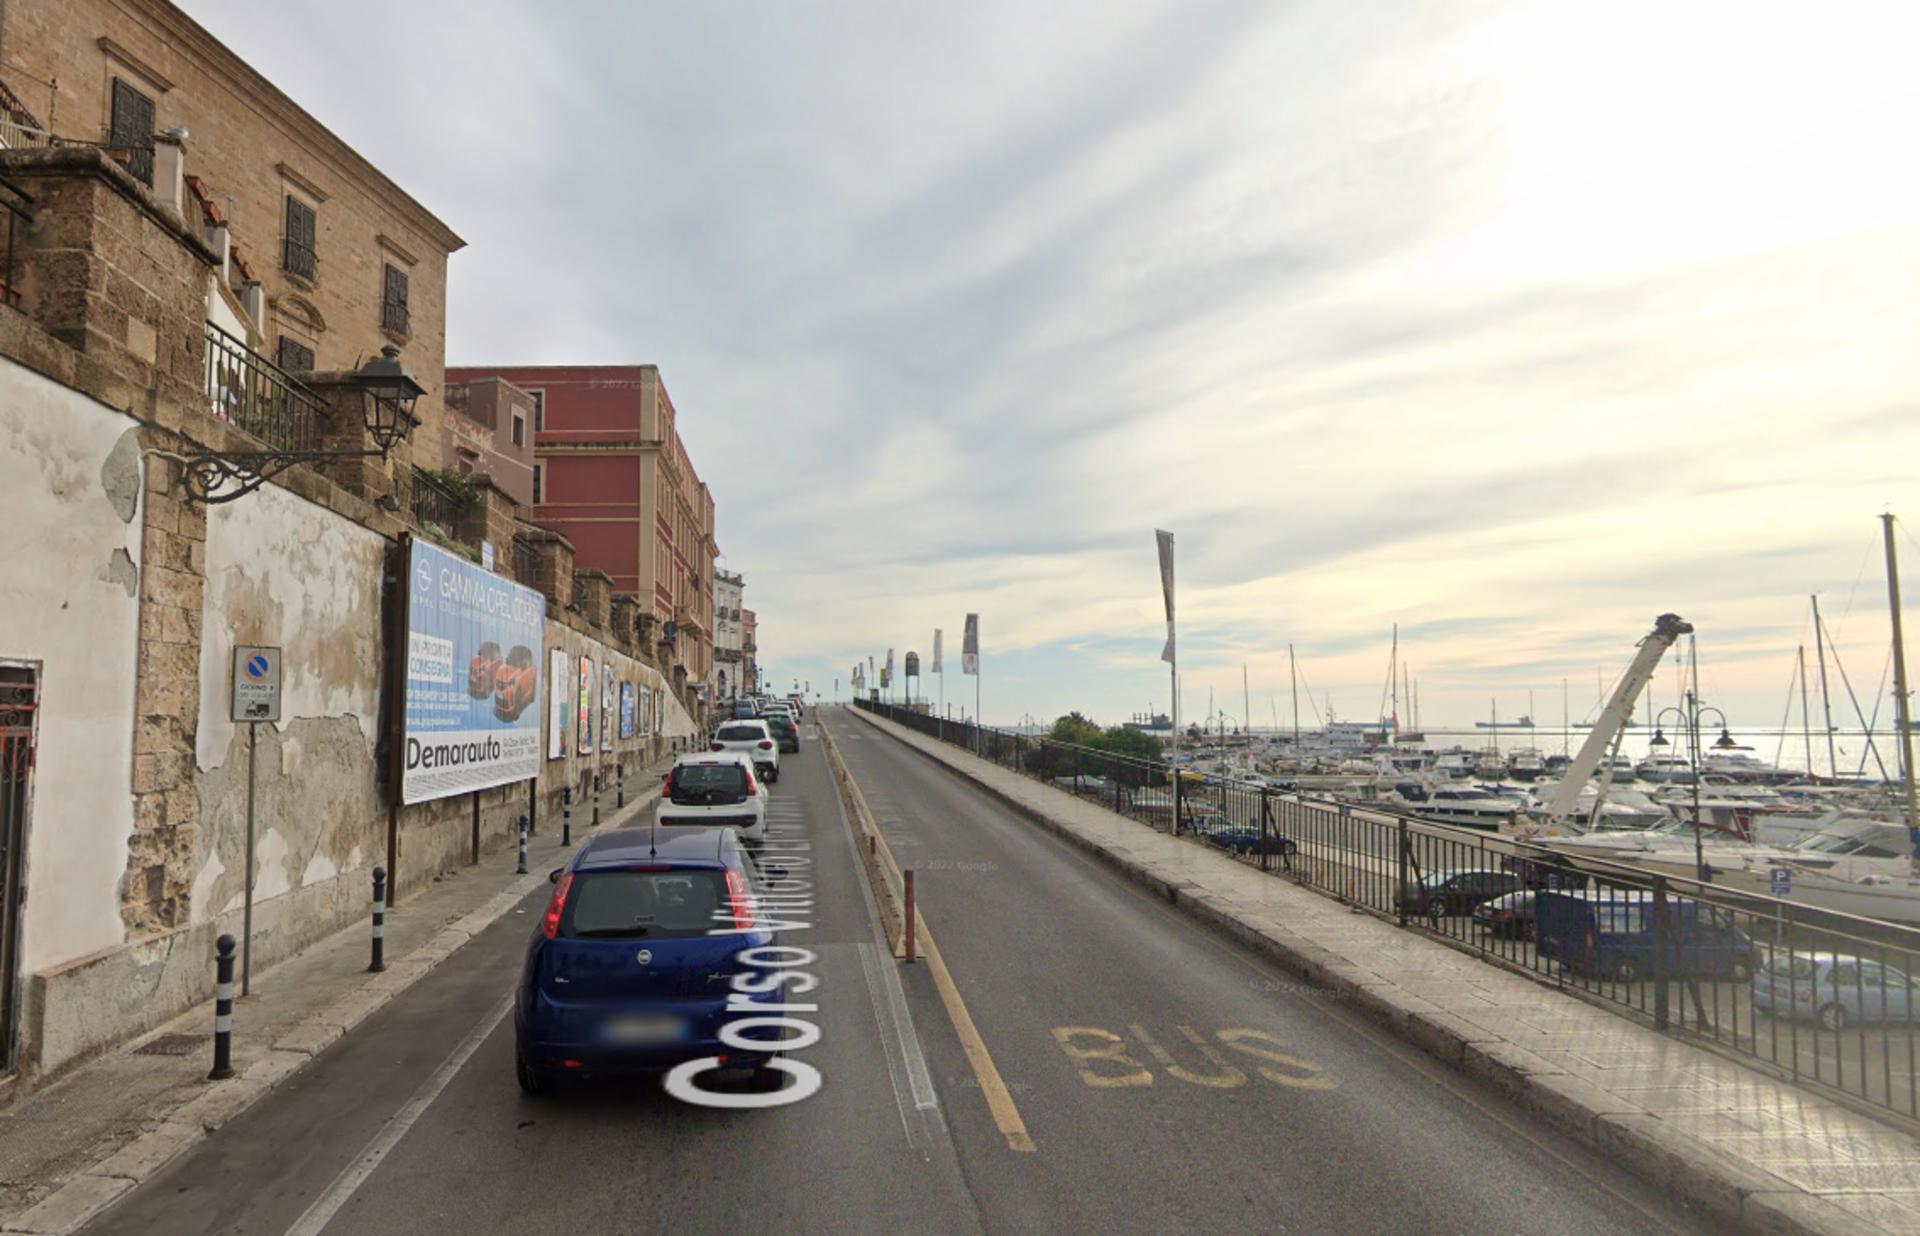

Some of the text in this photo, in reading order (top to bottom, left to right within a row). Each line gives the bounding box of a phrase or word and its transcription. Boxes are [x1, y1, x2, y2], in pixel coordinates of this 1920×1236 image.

[440, 567, 485, 609] GAMMA
[486, 586, 512, 619] OPEL
[406, 735, 500, 770] Demarauto
[1051, 1024, 1341, 1090] BUS
